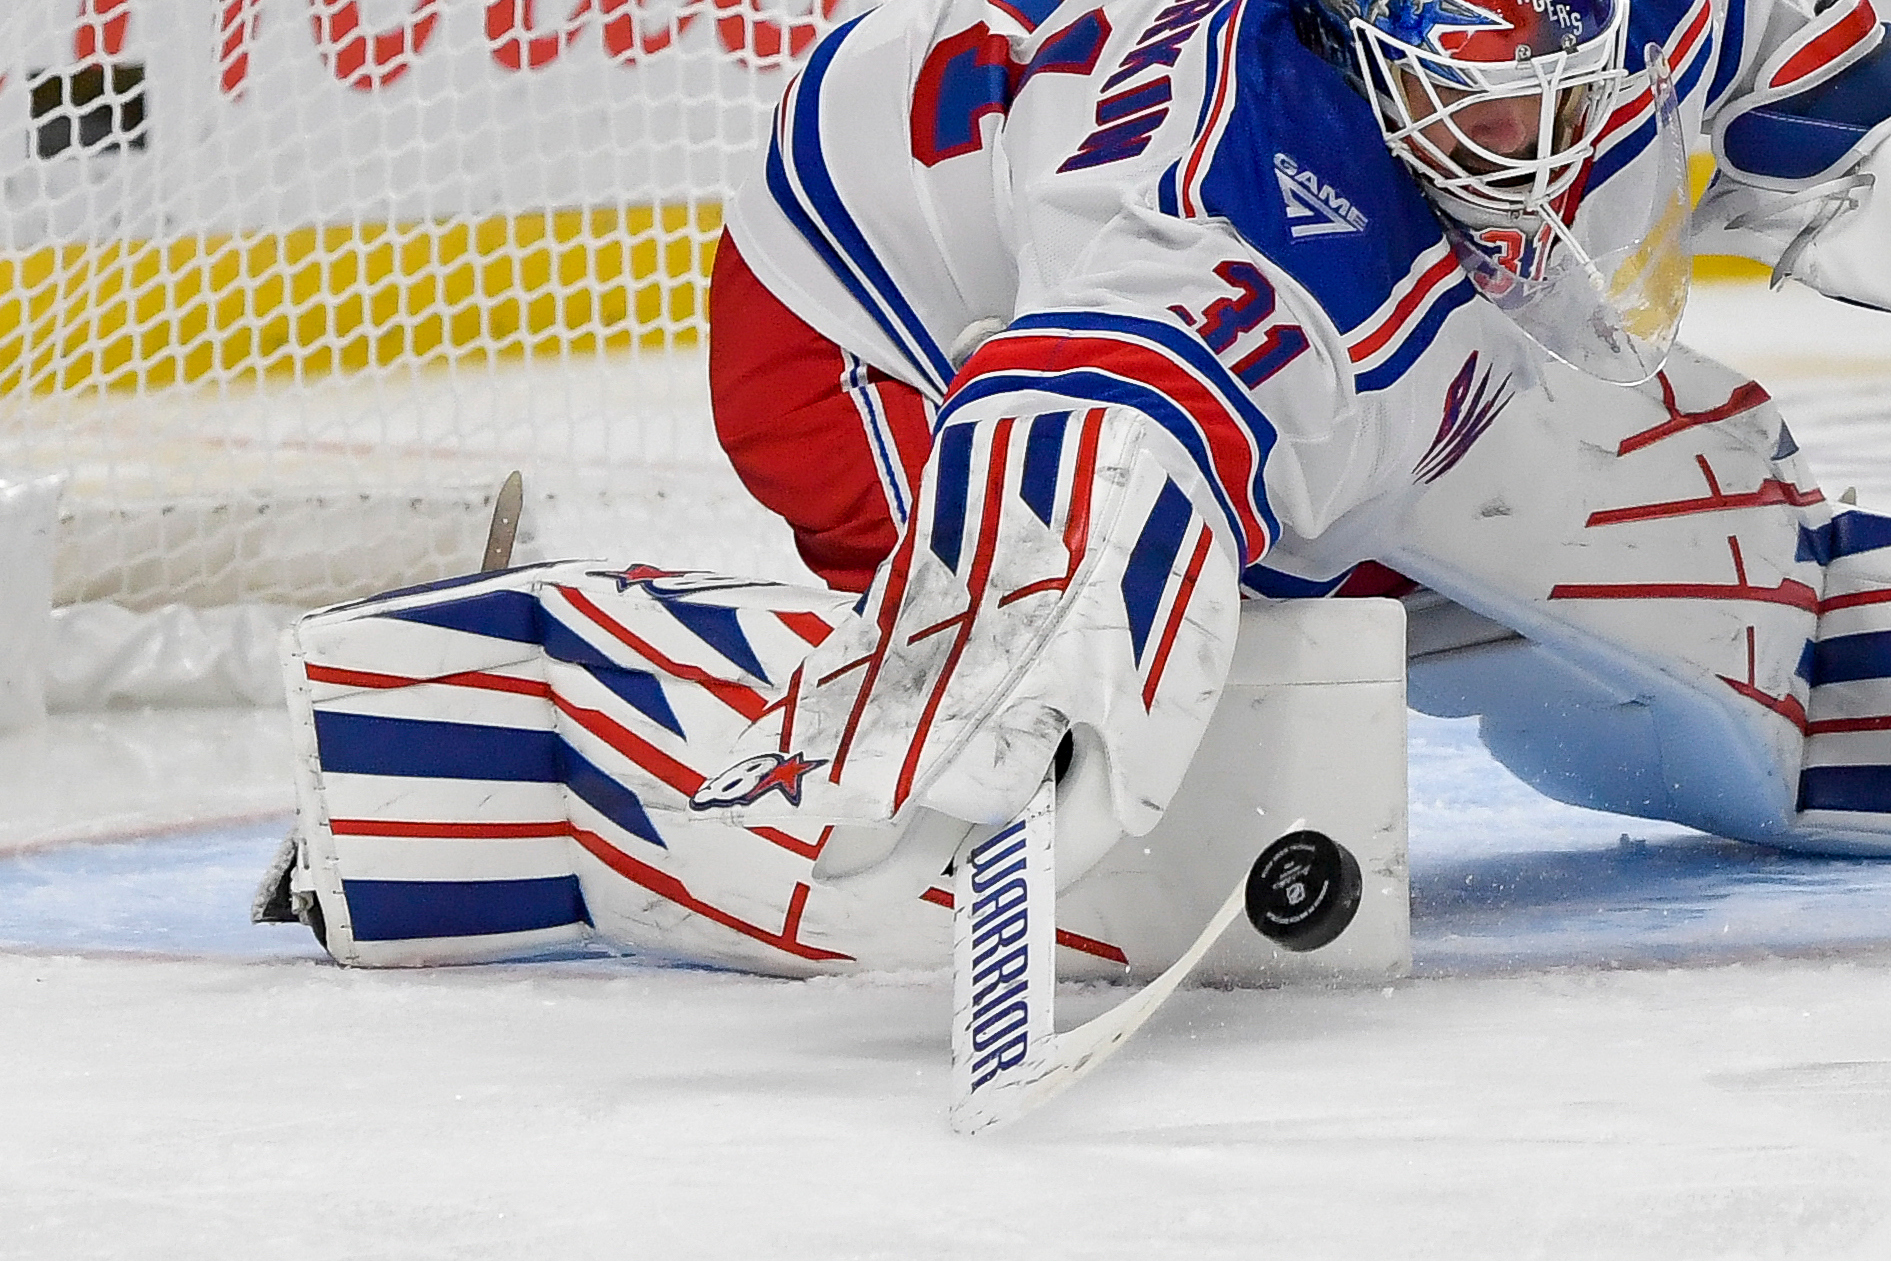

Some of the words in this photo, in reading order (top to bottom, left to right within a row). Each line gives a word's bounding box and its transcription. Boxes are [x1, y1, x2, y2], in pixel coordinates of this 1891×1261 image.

[1272, 152, 1369, 232] GAME
[1472, 221, 1557, 299] 31
[1166, 260, 1312, 392] 31
[970, 818, 1029, 1095] WARRIOR
